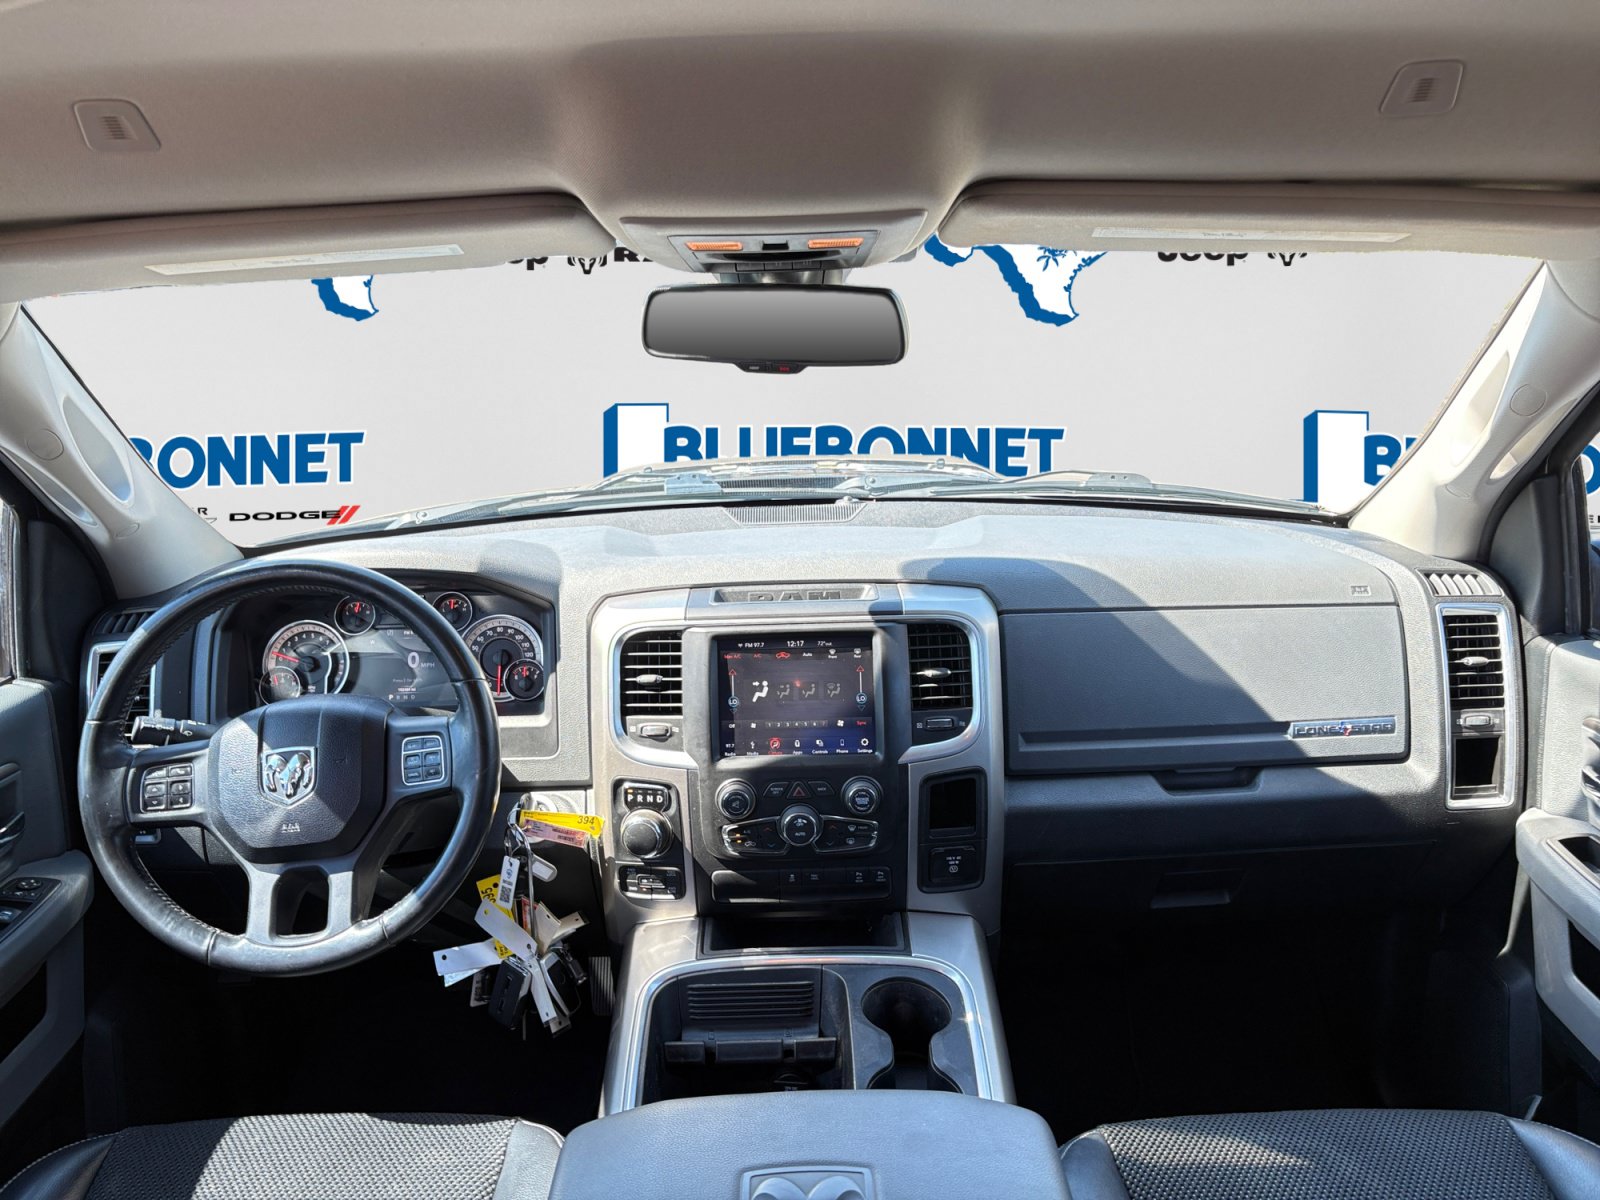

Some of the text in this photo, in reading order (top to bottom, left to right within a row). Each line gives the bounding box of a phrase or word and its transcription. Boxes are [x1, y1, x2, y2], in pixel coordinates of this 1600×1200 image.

[229, 510, 341, 521] DODGE
[748, 590, 840, 603] RAM
[407, 651, 419, 668] 0
[1294, 722, 1393, 736] LONE STAR
[656, 795, 664, 803] D
[577, 815, 595, 825] 394
